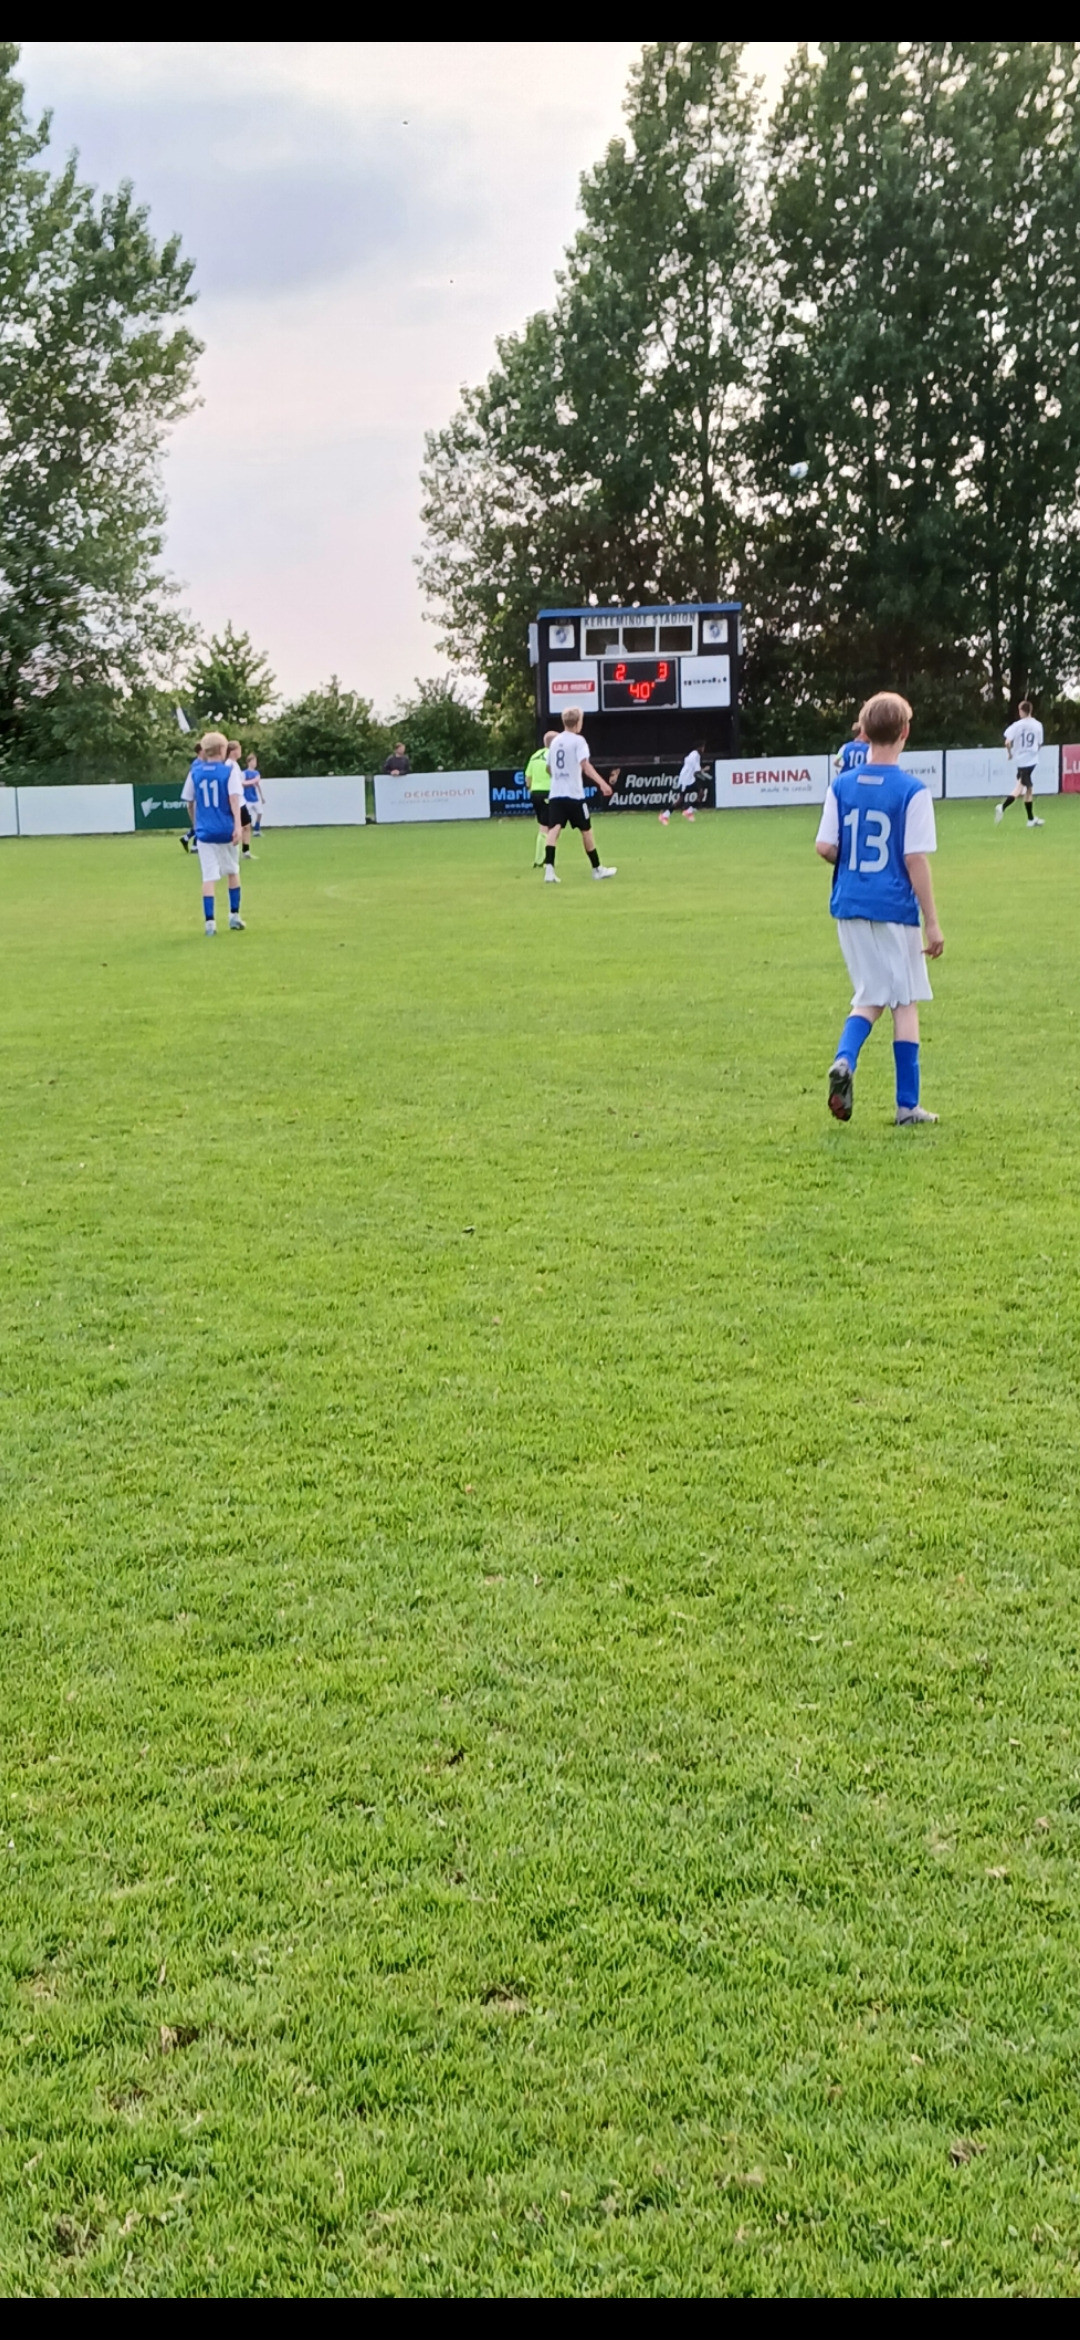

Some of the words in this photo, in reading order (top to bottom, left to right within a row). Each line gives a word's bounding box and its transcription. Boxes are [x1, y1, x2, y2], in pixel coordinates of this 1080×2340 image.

[653, 611, 696, 625] STADION
[615, 663, 626, 681] 2
[658, 661, 668, 680] 3
[1020, 732, 1035, 748] 19
[556, 749, 565, 769] 8
[849, 750, 865, 768] 10
[1062, 756, 1080, 774] Lu
[625, 773, 681, 789] Revning
[732, 769, 811, 785] BERNINA
[199, 779, 219, 808] 11
[608, 787, 708, 806] Autoværke
[844, 808, 891, 873] 13
